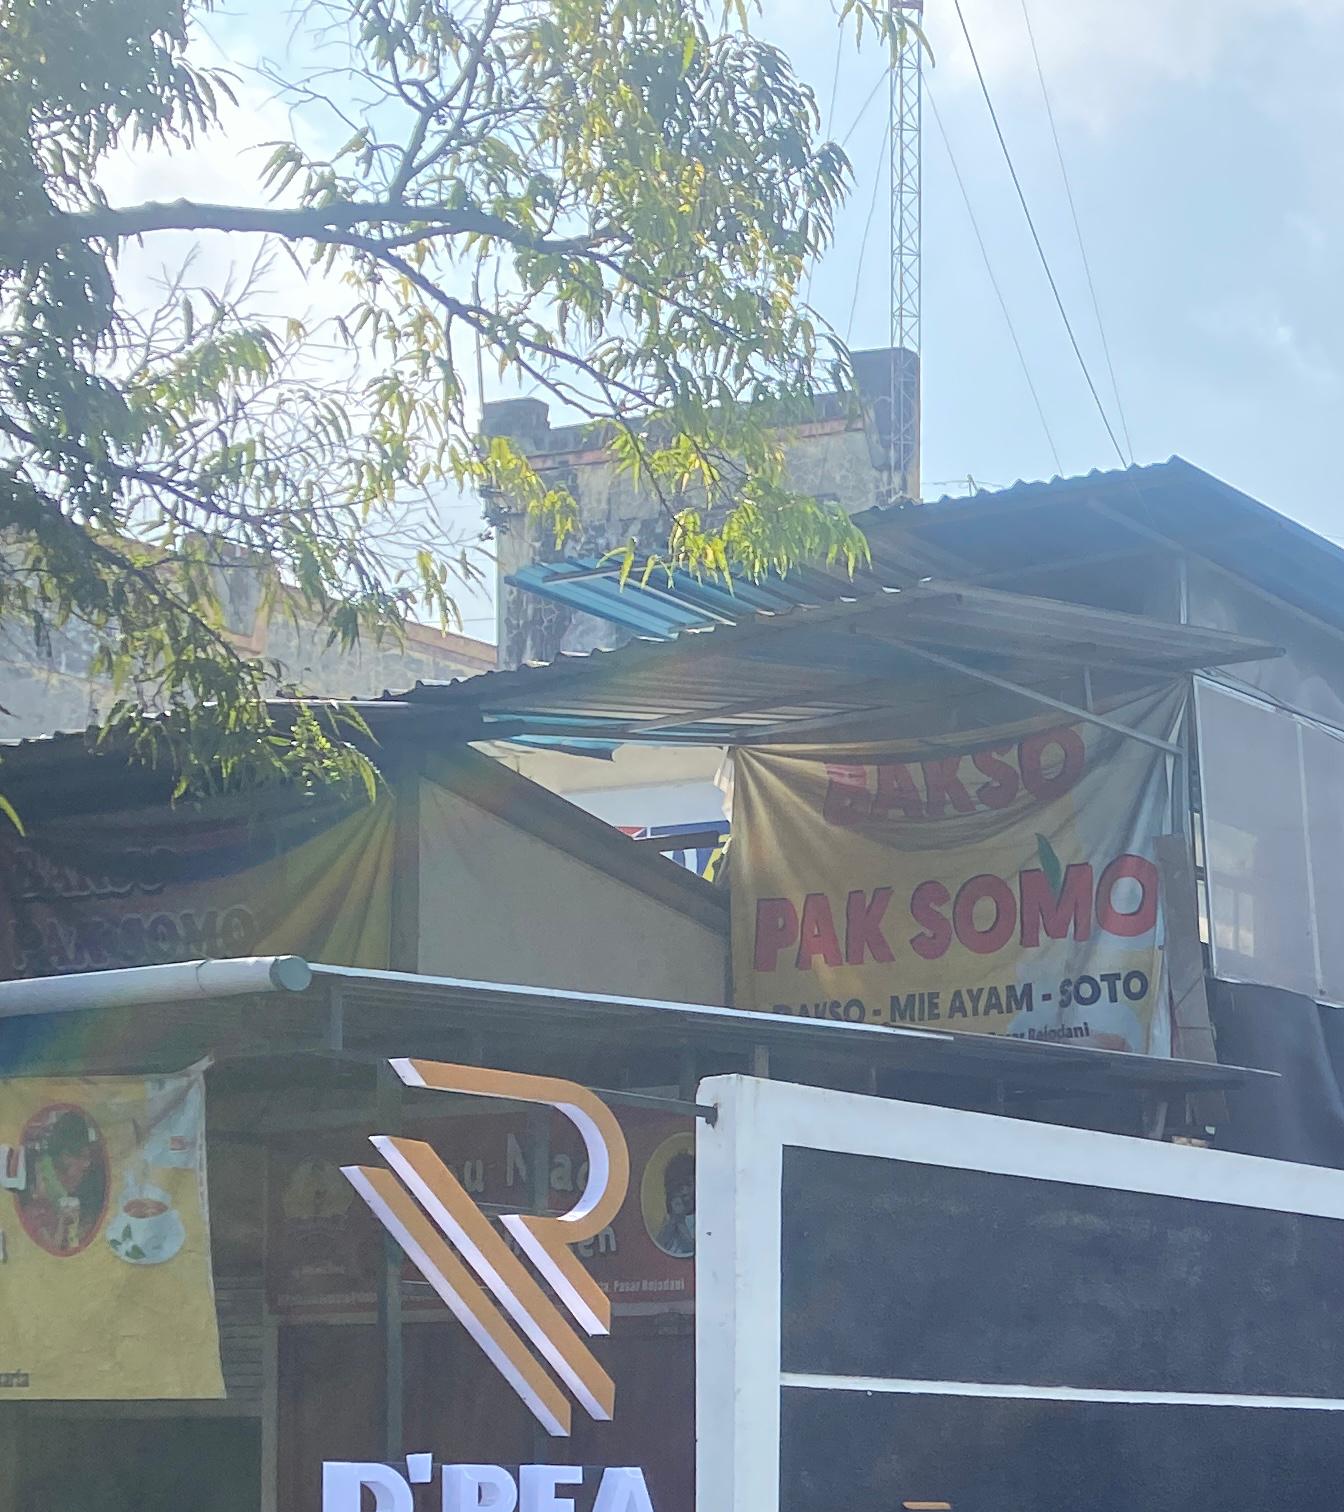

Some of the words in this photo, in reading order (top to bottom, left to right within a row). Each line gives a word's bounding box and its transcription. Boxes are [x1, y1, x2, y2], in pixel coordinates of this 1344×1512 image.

[824, 726, 1086, 826] BAKSO
[753, 885, 895, 972] PAK
[910, 853, 1159, 961] SOMO
[889, 989, 941, 1024] MIE
[948, 982, 1035, 1019] AYAM
[1059, 970, 1149, 1009] SOTO
